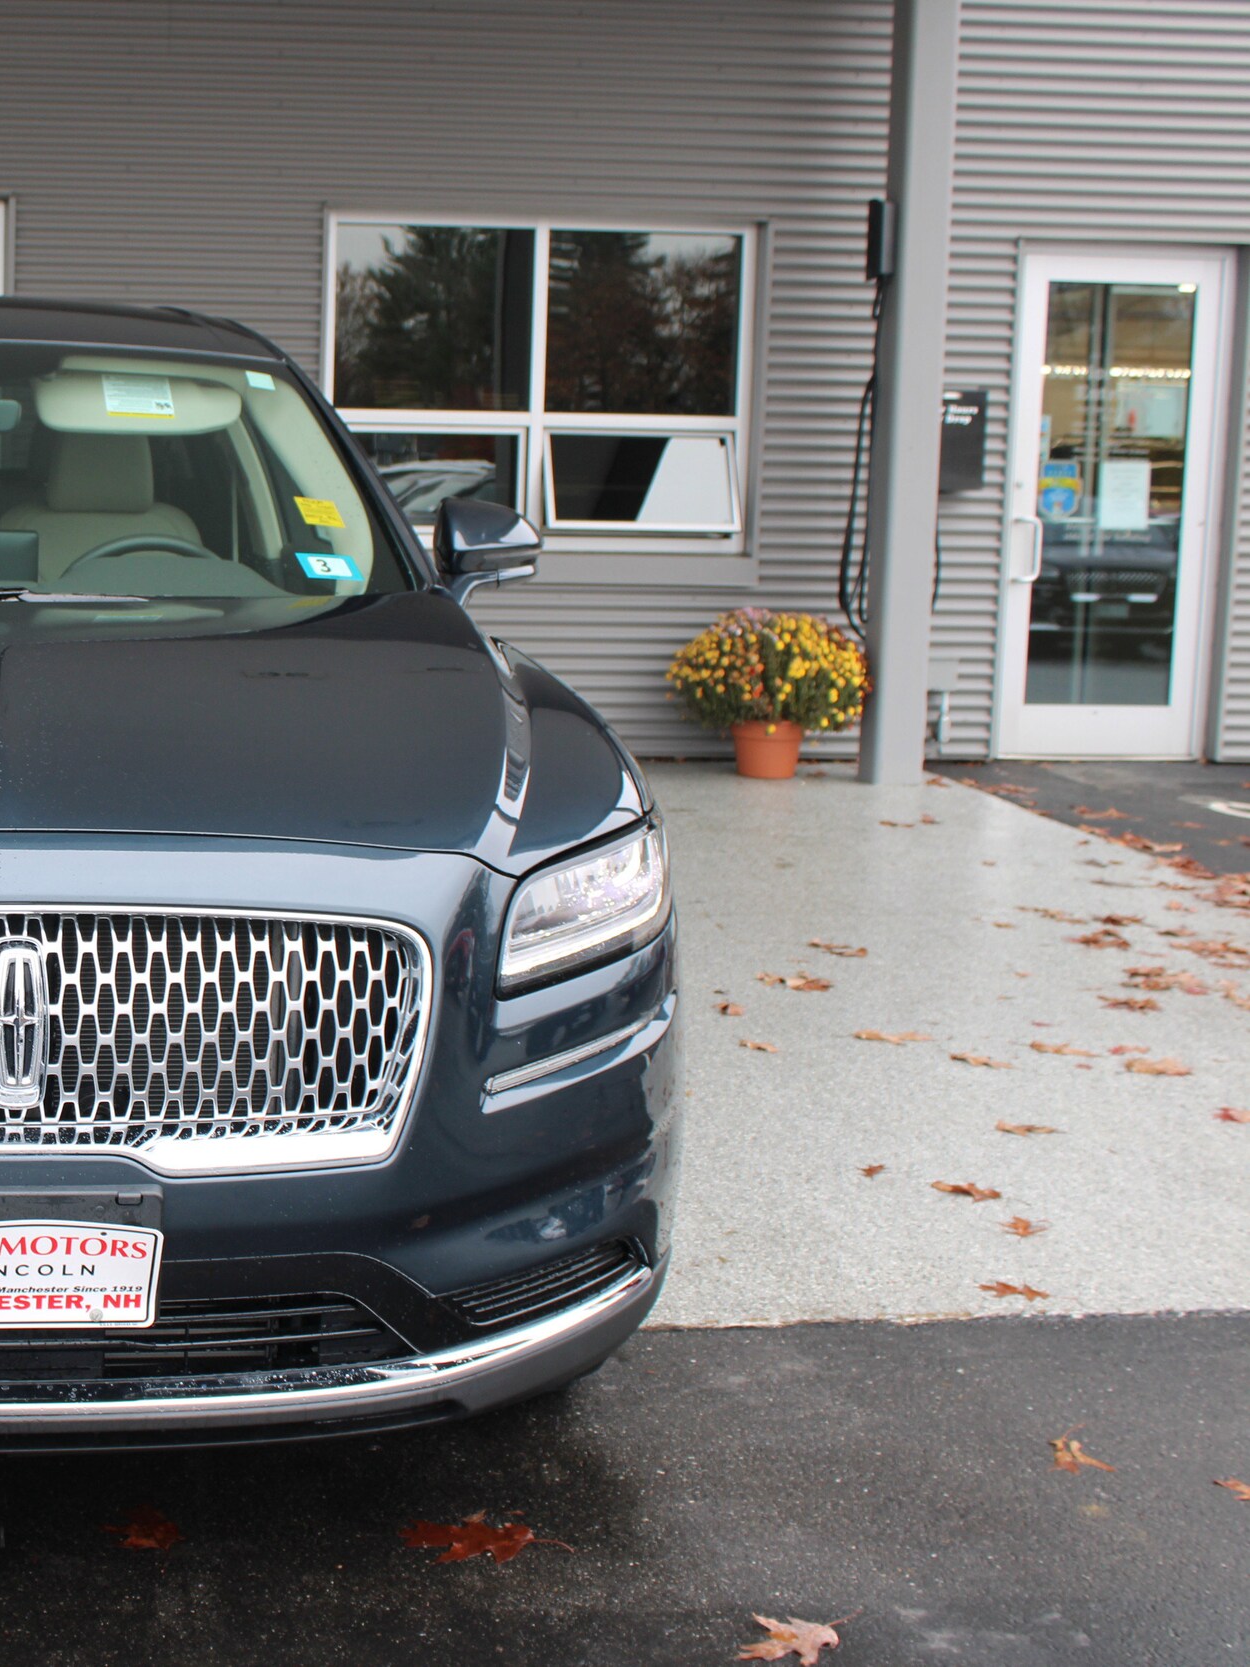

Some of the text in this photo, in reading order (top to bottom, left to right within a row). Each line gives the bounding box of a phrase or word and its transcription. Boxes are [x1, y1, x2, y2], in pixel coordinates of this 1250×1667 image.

[316, 559, 331, 573] 3
[72, 1285, 107, 1293] Since
[103, 1294, 142, 1309] NH
